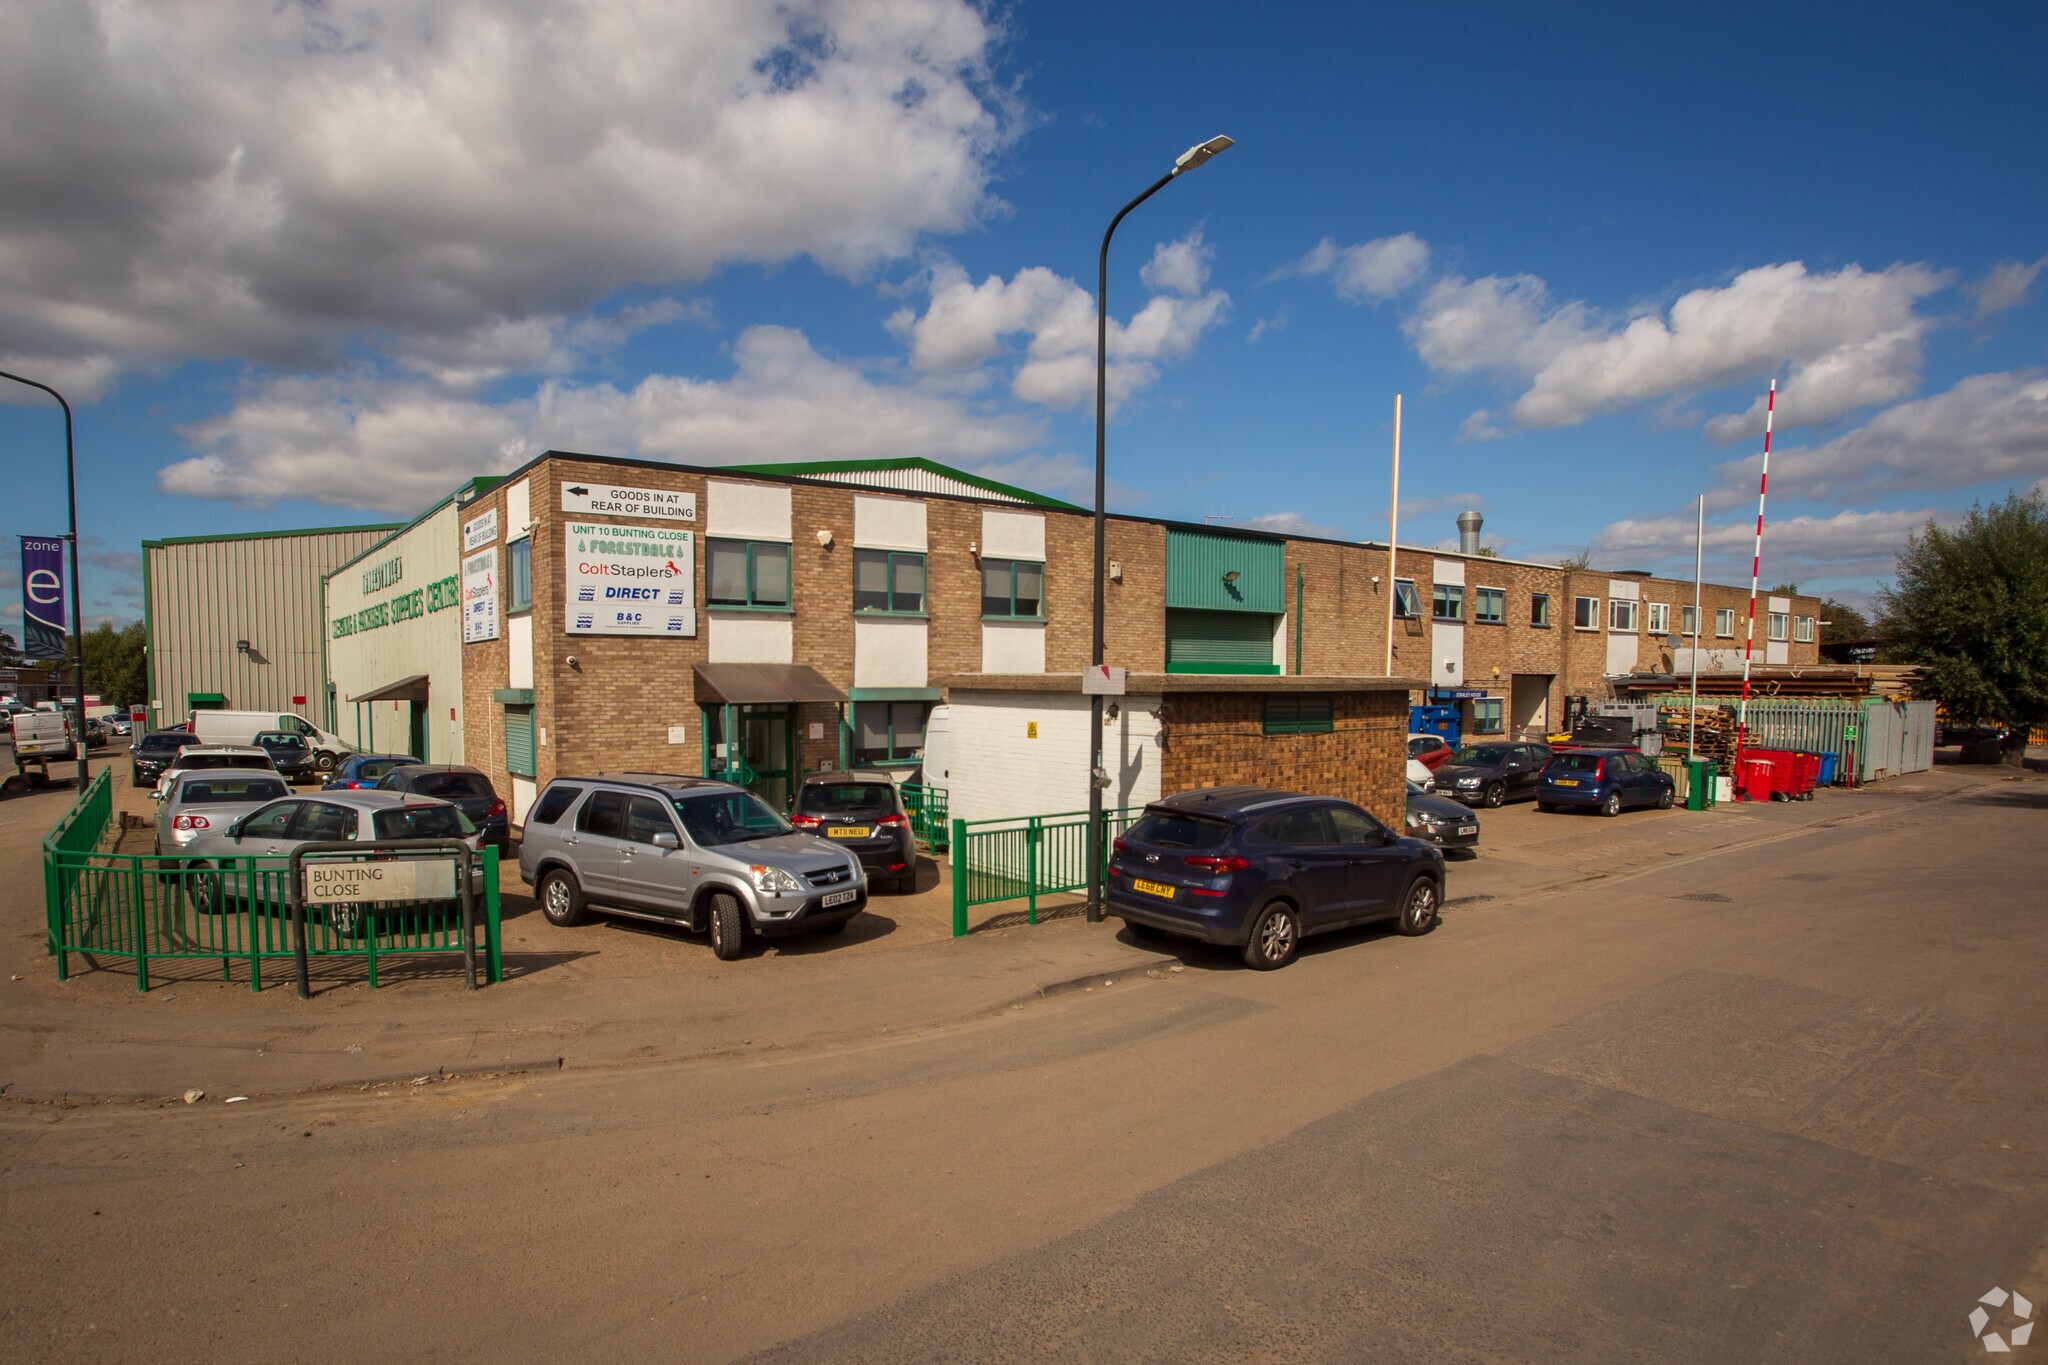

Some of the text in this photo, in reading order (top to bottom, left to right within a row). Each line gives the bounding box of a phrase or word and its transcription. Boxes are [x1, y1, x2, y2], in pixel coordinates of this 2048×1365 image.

[610, 489, 679, 504] GOODS IN AT
[591, 500, 693, 518] REAR OF BUILDING
[572, 525, 688, 541] UNIT 10 BUNTING CLOSE
[25, 541, 60, 552] zone
[589, 539, 675, 558] FORESTDALE
[579, 562, 673, 579] ColtStaplers
[26, 569, 60, 604] e
[605, 587, 661, 600] DIRECT
[390, 587, 424, 625] SUPPLIES
[426, 573, 459, 614] CENTRE
[313, 868, 383, 883] BUNTING
[313, 884, 361, 898] CLOSE
[825, 890, 854, 906] LE02 TZA
